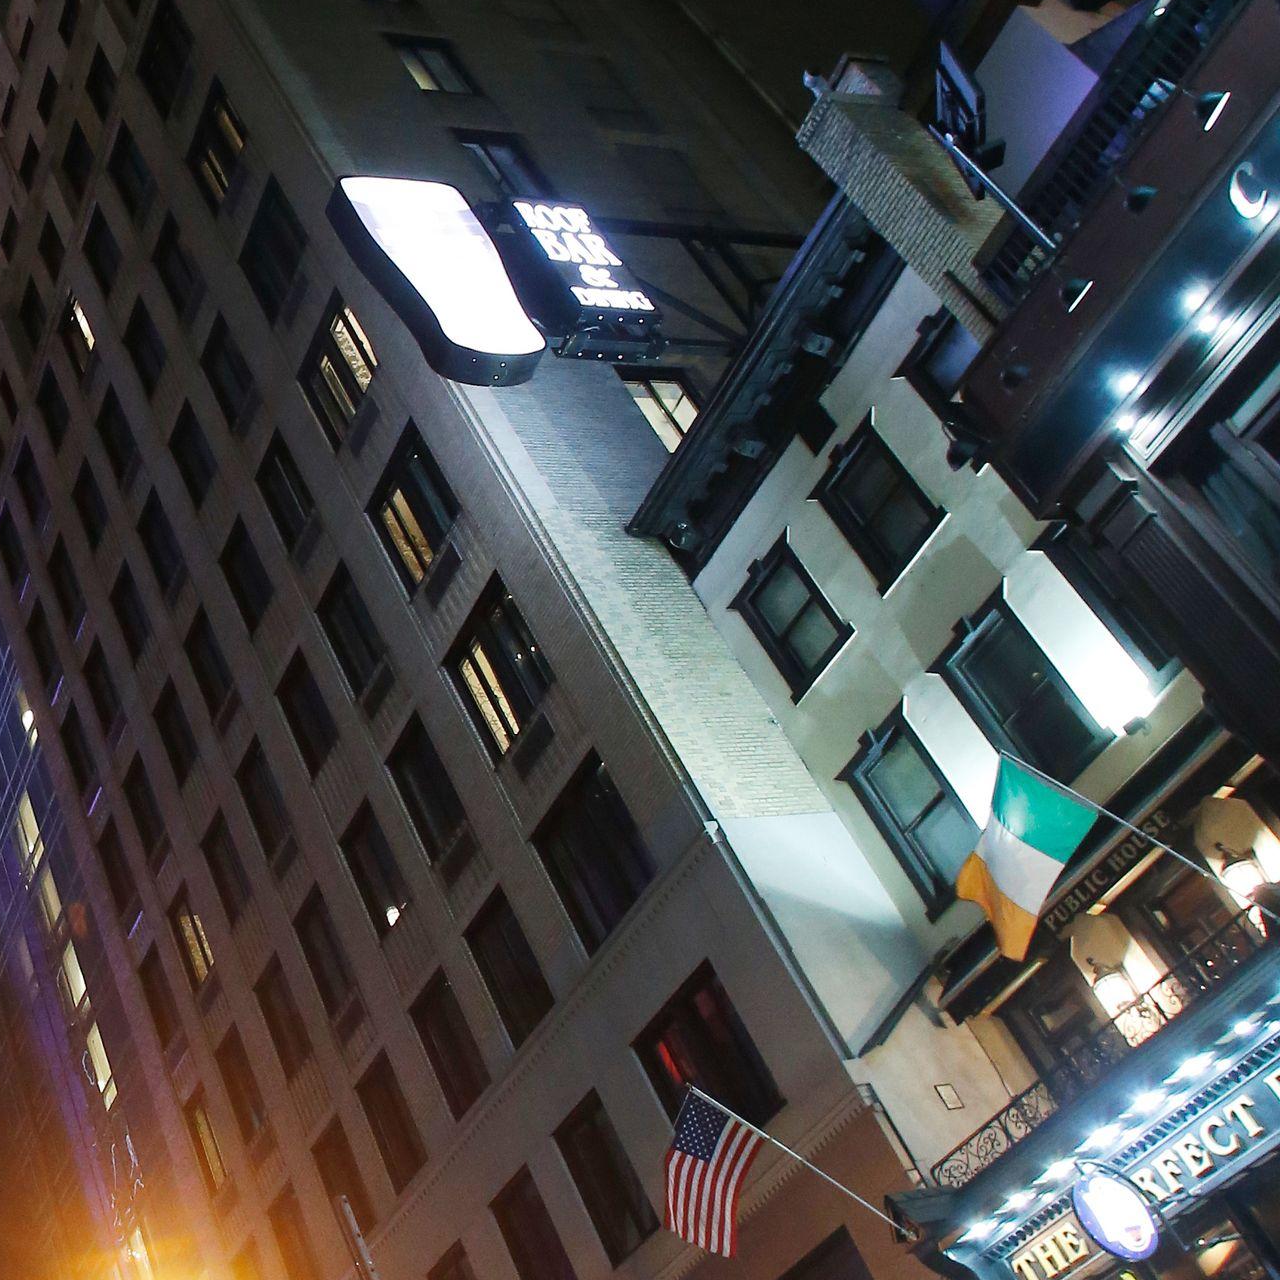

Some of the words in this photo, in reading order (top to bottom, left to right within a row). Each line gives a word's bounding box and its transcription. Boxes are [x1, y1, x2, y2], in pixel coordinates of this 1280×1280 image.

[513, 201, 592, 234] ROOF
[531, 228, 624, 266] BAR
[578, 264, 619, 288] &
